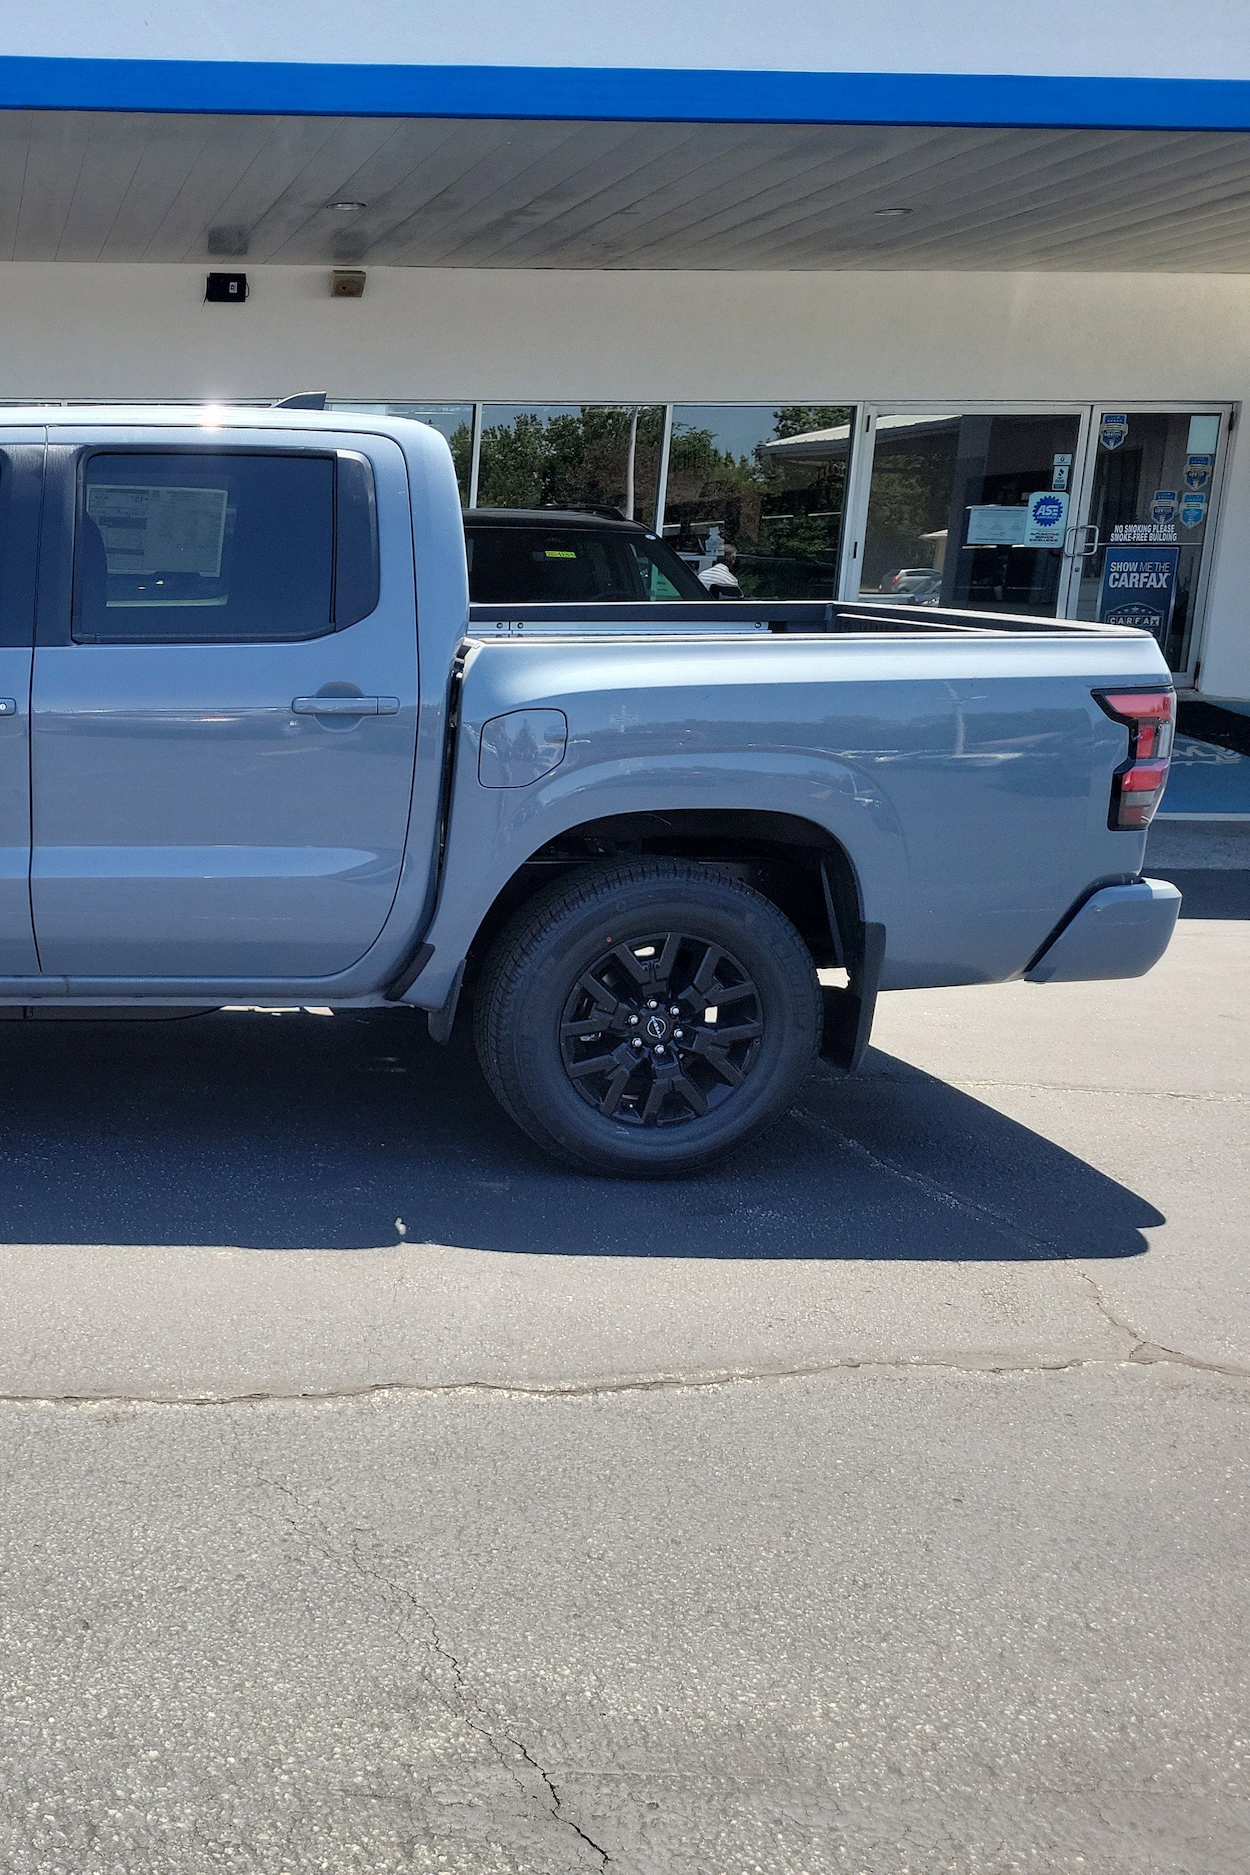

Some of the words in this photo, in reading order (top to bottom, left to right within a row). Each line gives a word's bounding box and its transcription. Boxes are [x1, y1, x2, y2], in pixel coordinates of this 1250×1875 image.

[1036, 505, 1059, 515] ASE
[1114, 525, 1124, 533] NO
[1124, 524, 1152, 533] SMOKING
[1152, 524, 1175, 533] PLEASE
[1110, 533, 1148, 542] SMOKE-FREE
[1149, 533, 1177, 542] BUILDING
[1110, 561, 1138, 572] SHOW
[1139, 562, 1153, 572] ME
[1154, 562, 1170, 572] THE
[1108, 572, 1168, 589] CARFAX
[1109, 617, 1158, 625] CARFAX
